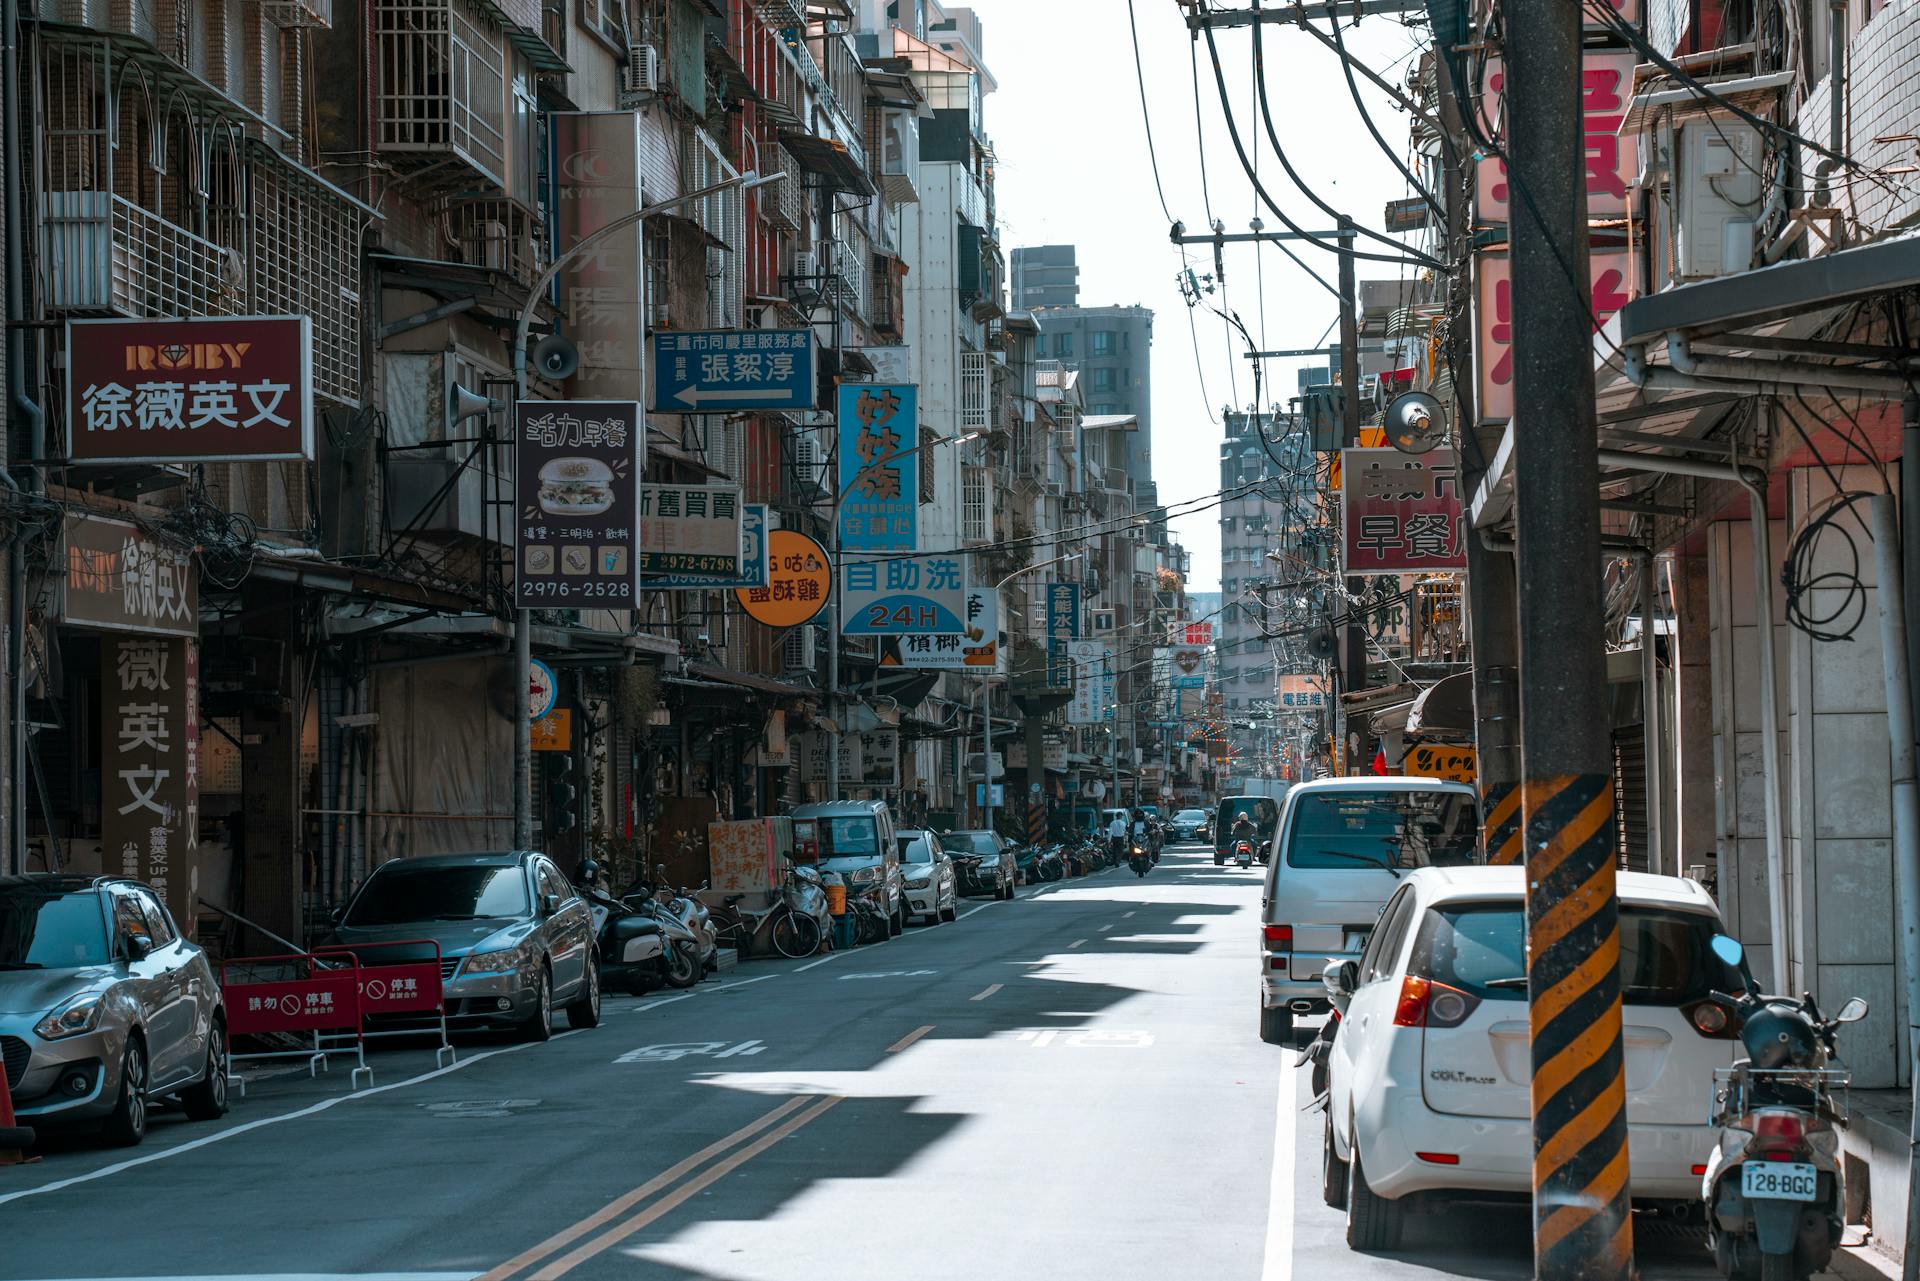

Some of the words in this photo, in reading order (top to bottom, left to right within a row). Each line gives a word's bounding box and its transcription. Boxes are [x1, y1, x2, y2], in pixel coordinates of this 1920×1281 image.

[660, 334, 806, 351] 三重市同慶里服務處
[675, 356, 687, 381] 里長
[701, 352, 795, 383] 張絮淳
[82, 378, 291, 432] 徐薇英文
[526, 413, 626, 447] 活力早餐
[523, 527, 547, 540] 漢堡
[560, 527, 593, 540] 三明治
[605, 527, 628, 540] 飲料
[661, 556, 734, 571] 2972-6798
[122, 537, 192, 623] 徐薇英文
[847, 559, 961, 592] 自助洗
[523, 582, 630, 597] 2976-2528
[868, 606, 937, 628] 24H
[1283, 692, 1327, 706] 電話維
[390, 979, 417, 991] 停車
[305, 992, 333, 1006] 停車
[1747, 1174, 1814, 1194] 128-BGC
